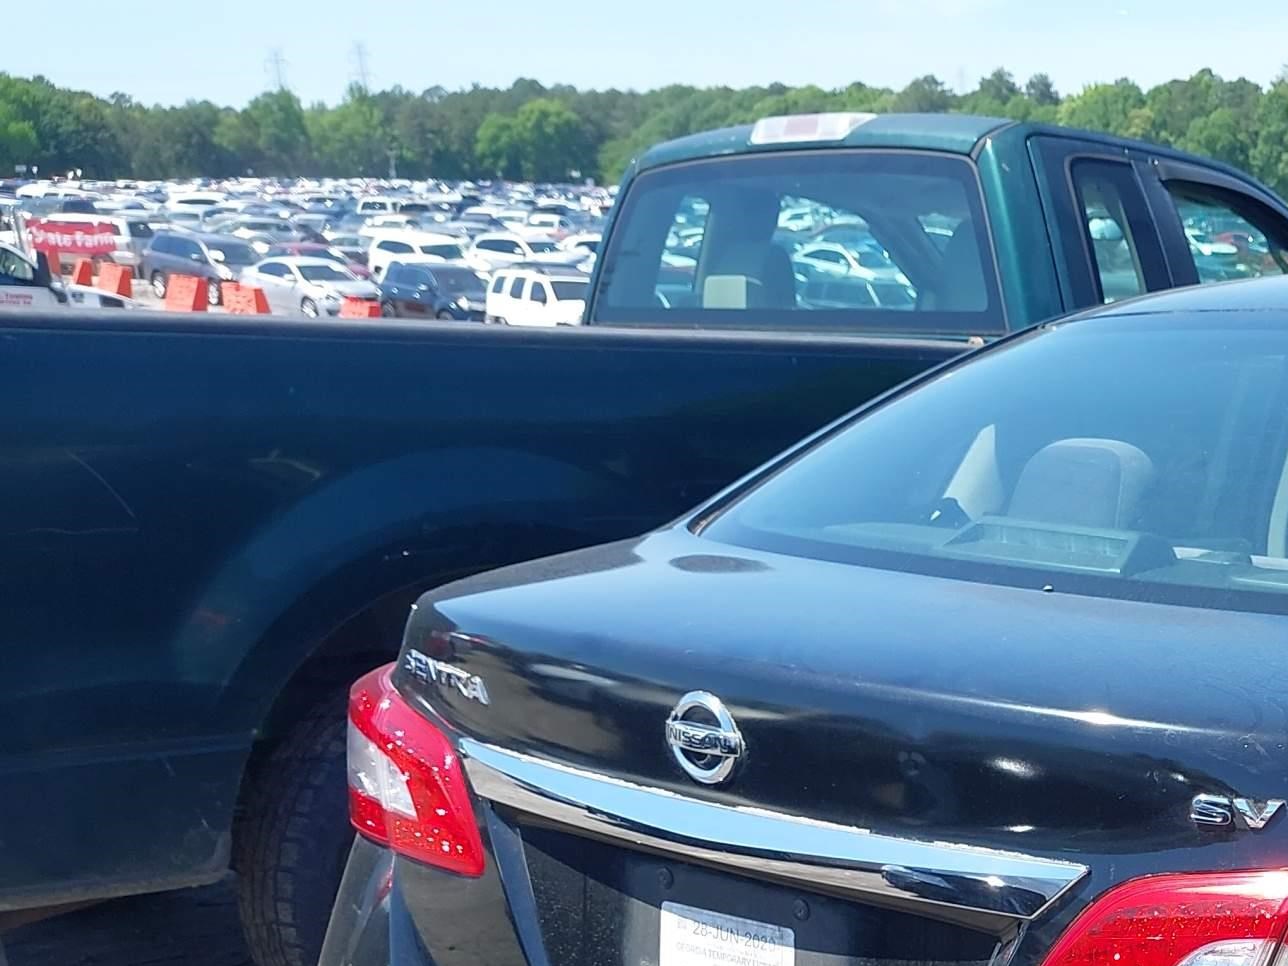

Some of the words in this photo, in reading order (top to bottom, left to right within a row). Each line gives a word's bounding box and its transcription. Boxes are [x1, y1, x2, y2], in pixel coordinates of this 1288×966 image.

[404, 648, 490, 704] SENTRA
[668, 725, 739, 755] NISSAN
[1188, 793, 1288, 829] SV
